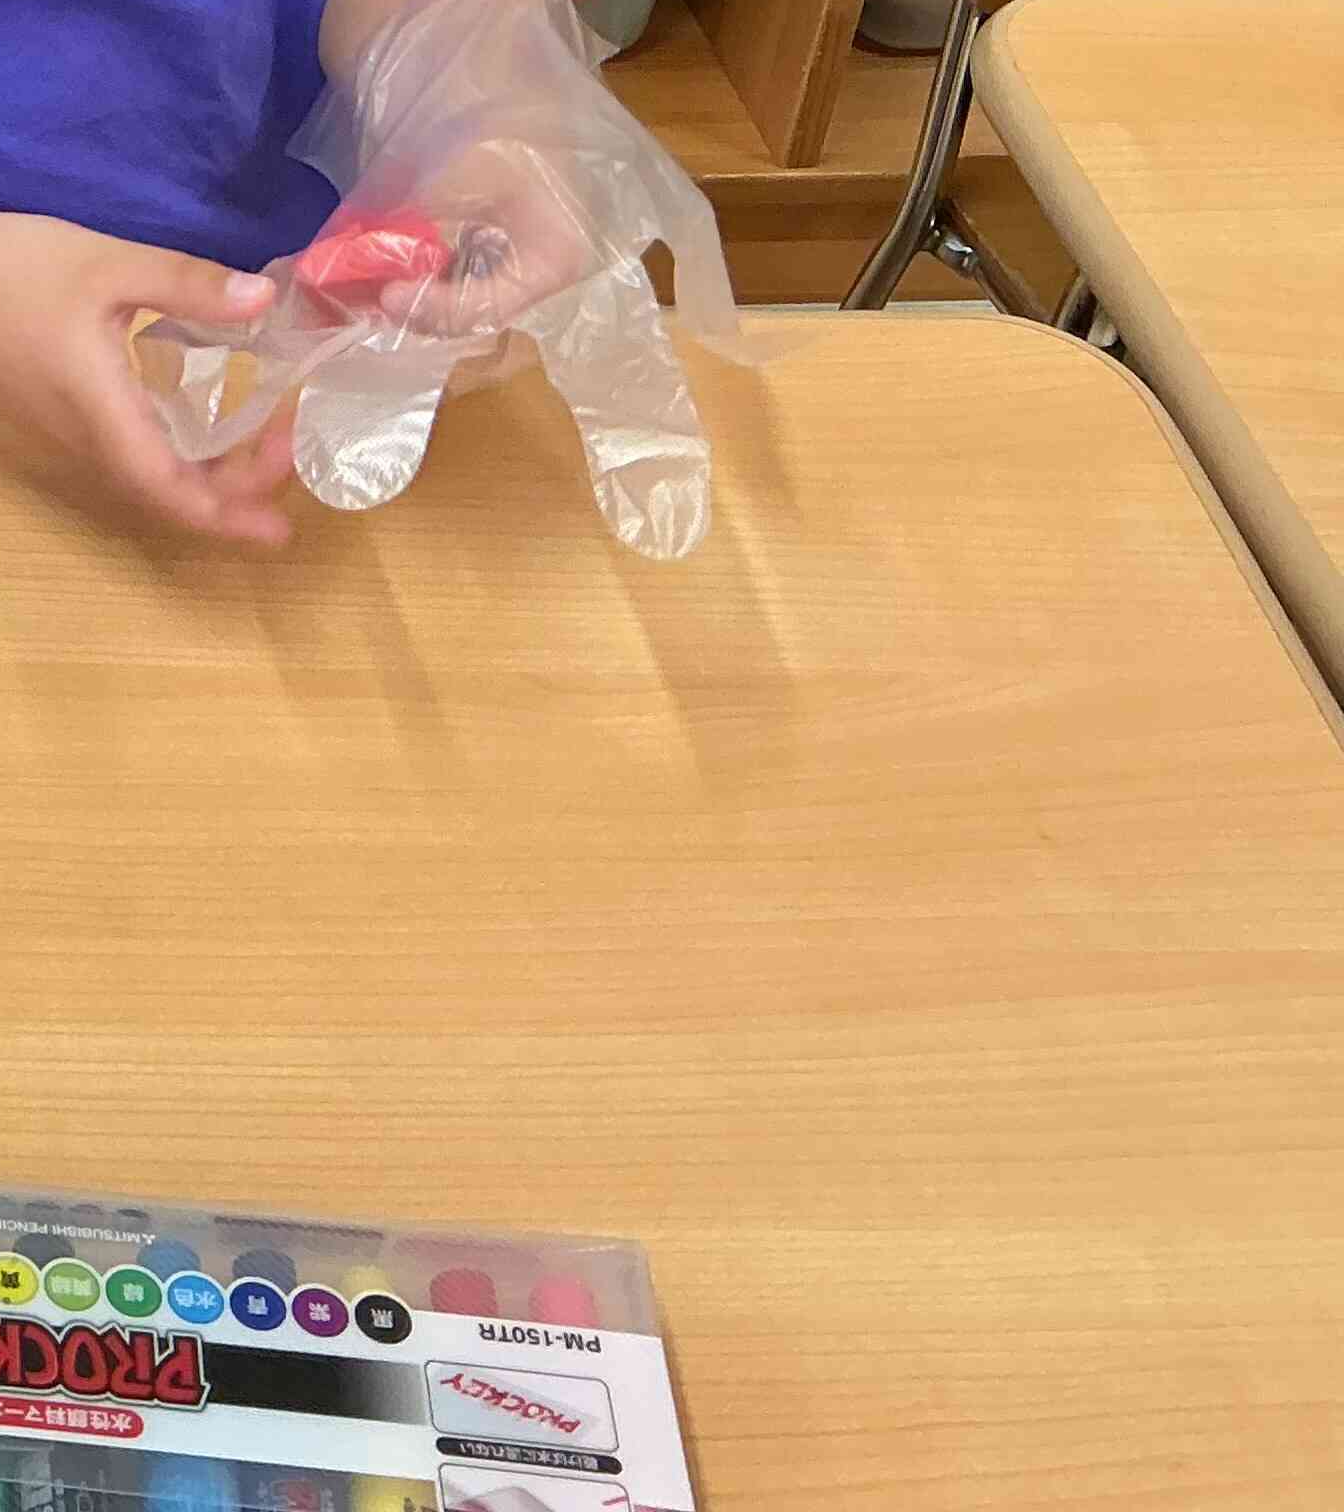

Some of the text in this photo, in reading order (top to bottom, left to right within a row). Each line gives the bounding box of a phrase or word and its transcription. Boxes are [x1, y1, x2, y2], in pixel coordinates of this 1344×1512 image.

[51, 1224, 141, 1243] MITSUBISHI
[174, 1287, 219, 1310] 水色
[247, 1295, 269, 1315] 青
[309, 1302, 331, 1322] 紫
[370, 1309, 394, 1329] 黒
[478, 1323, 602, 1353] PM-150TR
[440, 1373, 581, 1434] PROCKEY
